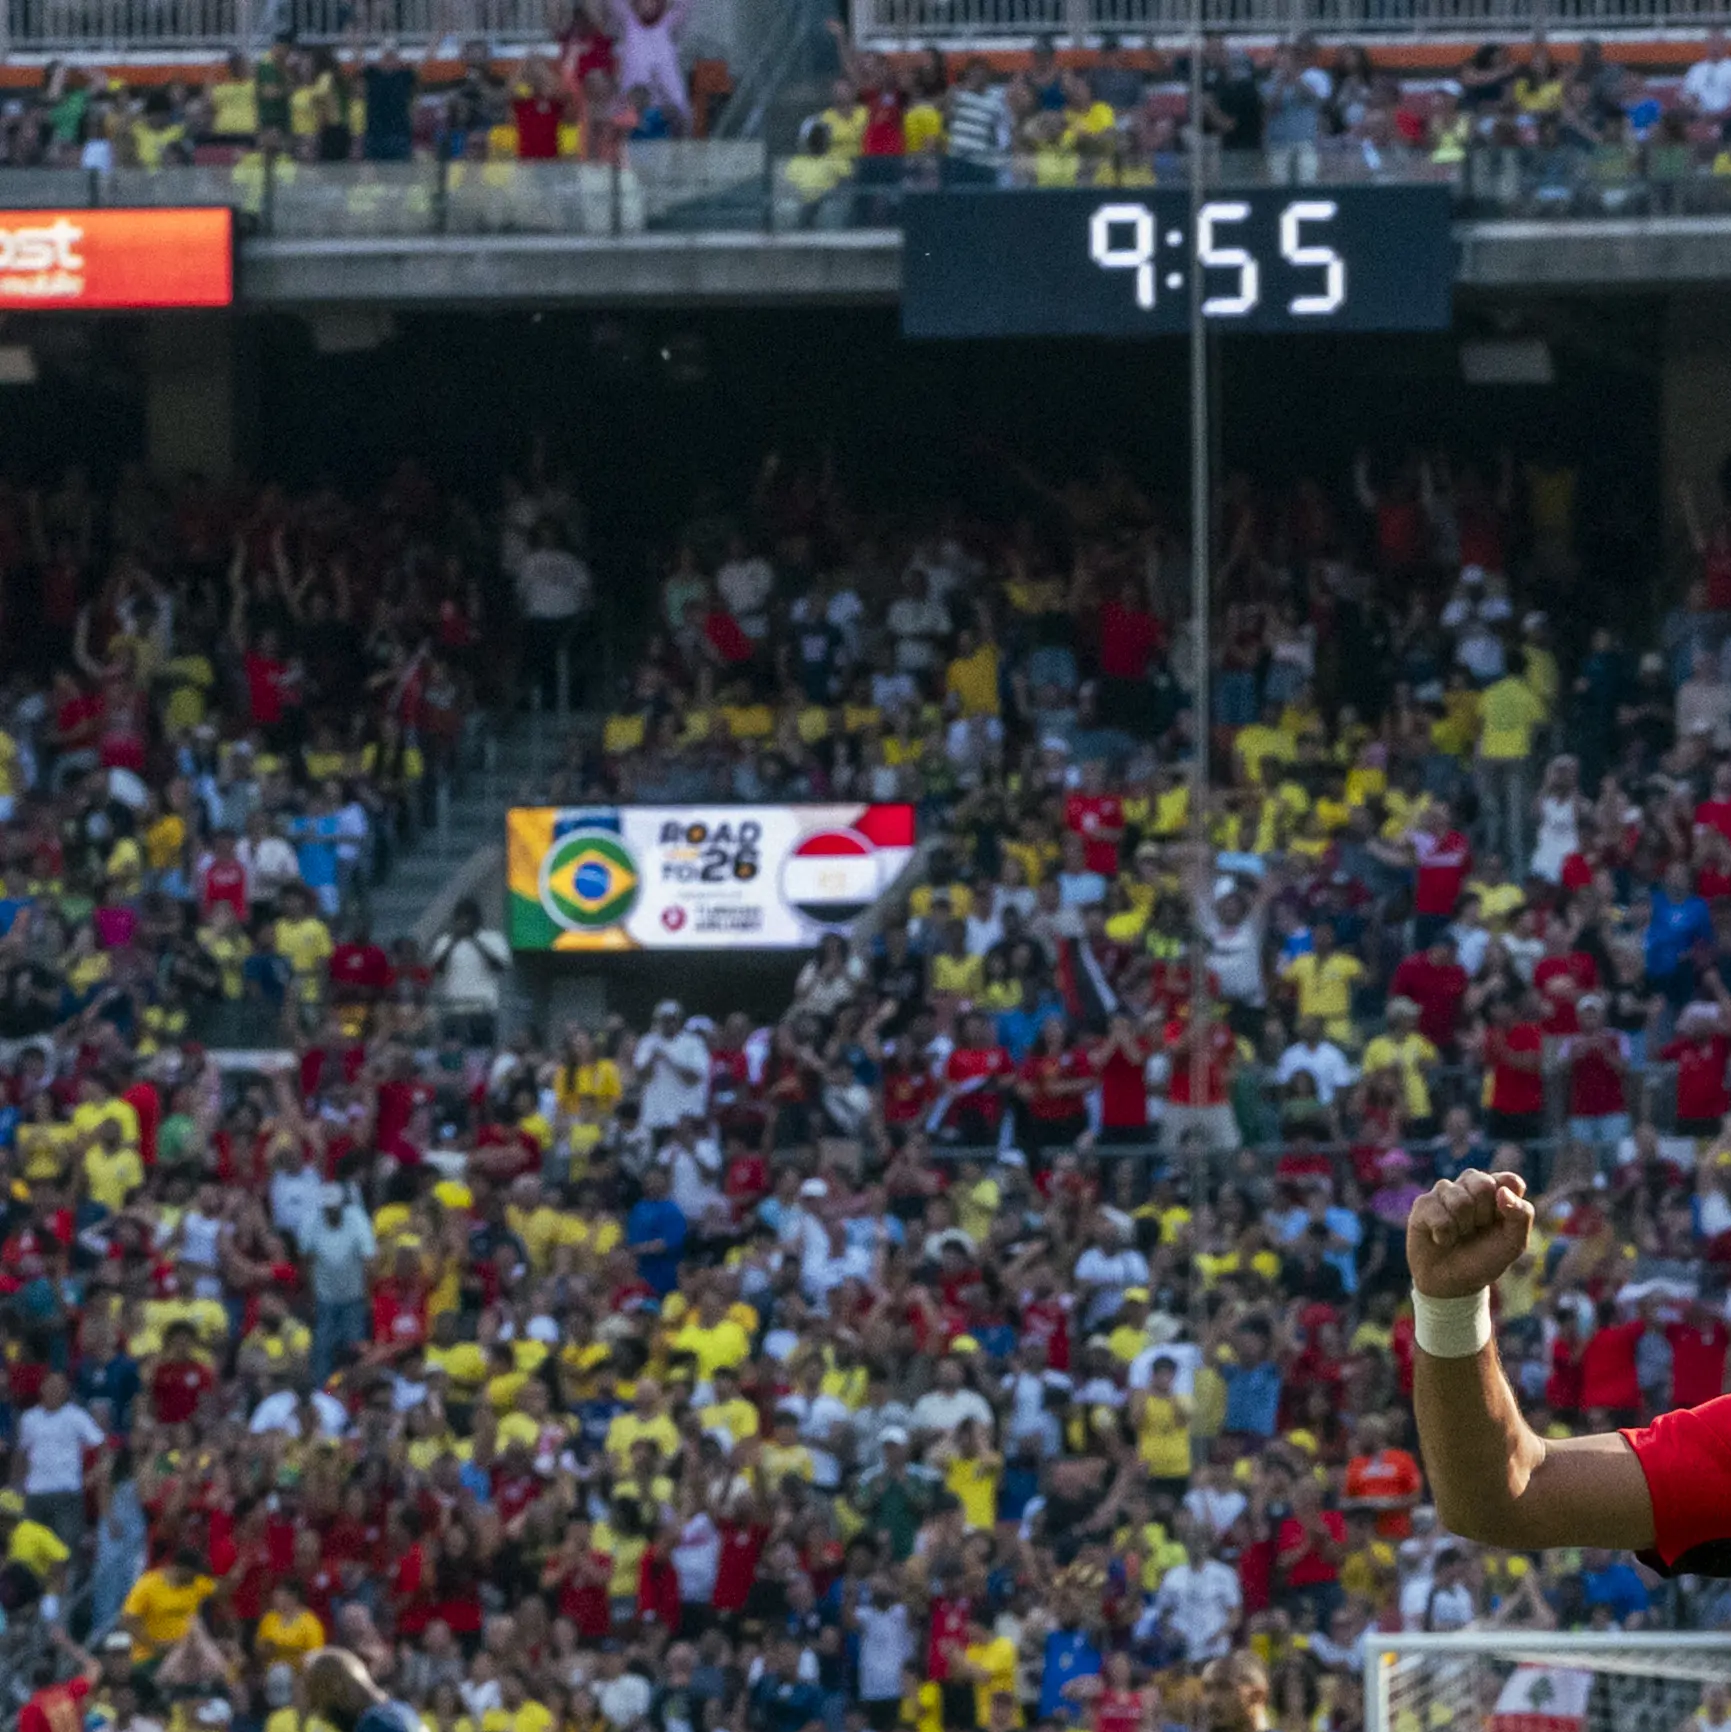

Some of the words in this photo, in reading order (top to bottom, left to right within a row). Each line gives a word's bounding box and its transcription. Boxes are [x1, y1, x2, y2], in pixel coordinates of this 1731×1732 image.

[1090, 201, 1345, 316] 9:55
[659, 821, 762, 843] ROAD
[701, 847, 758, 882] 26
